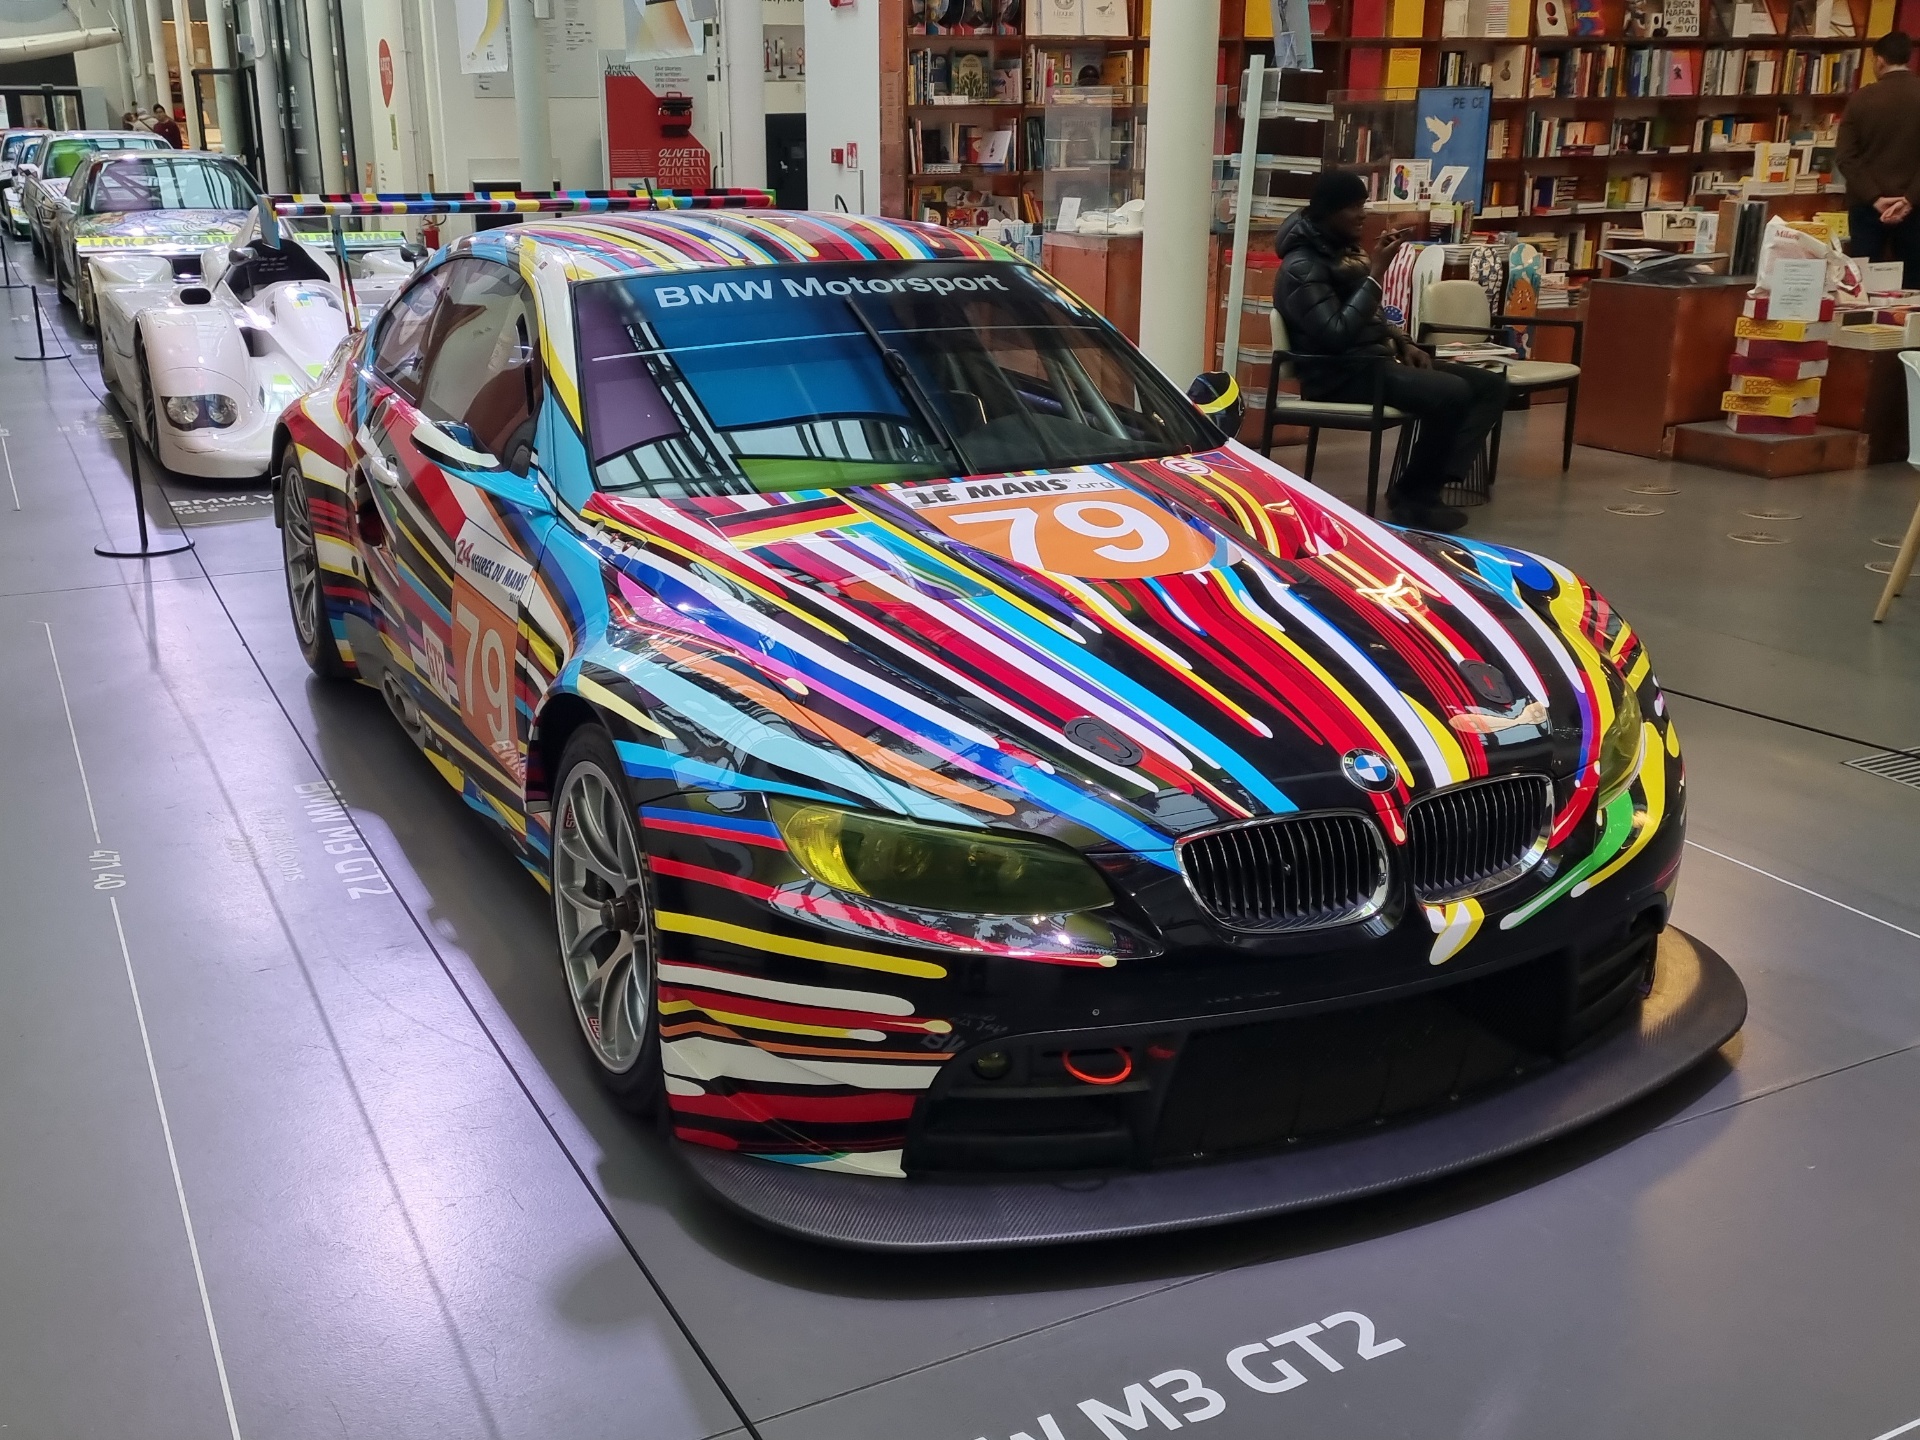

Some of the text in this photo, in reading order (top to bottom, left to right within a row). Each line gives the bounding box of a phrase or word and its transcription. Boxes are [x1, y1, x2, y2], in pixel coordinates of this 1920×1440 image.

[1685, 25, 1698, 33] VO
[658, 148, 705, 158] OLIVETTI
[658, 158, 706, 167] OLIVETTI
[658, 166, 707, 176] OLIVETTI
[658, 176, 707, 186] OLIVETTI
[90, 237, 136, 248] LACK
[653, 273, 1010, 309] BMW Motorsport
[169, 495, 247, 506] BMW
[913, 486, 956, 505] LE
[968, 478, 1069, 499] MANS
[948, 500, 1171, 571] 79
[456, 537, 529, 592] 24 HEURES DU MANS
[456, 600, 510, 742] 79
[293, 779, 395, 900] BMW M3 GT2
[272, 845, 306, 883] Koons
[1075, 1311, 1407, 1440] M3 GT2
